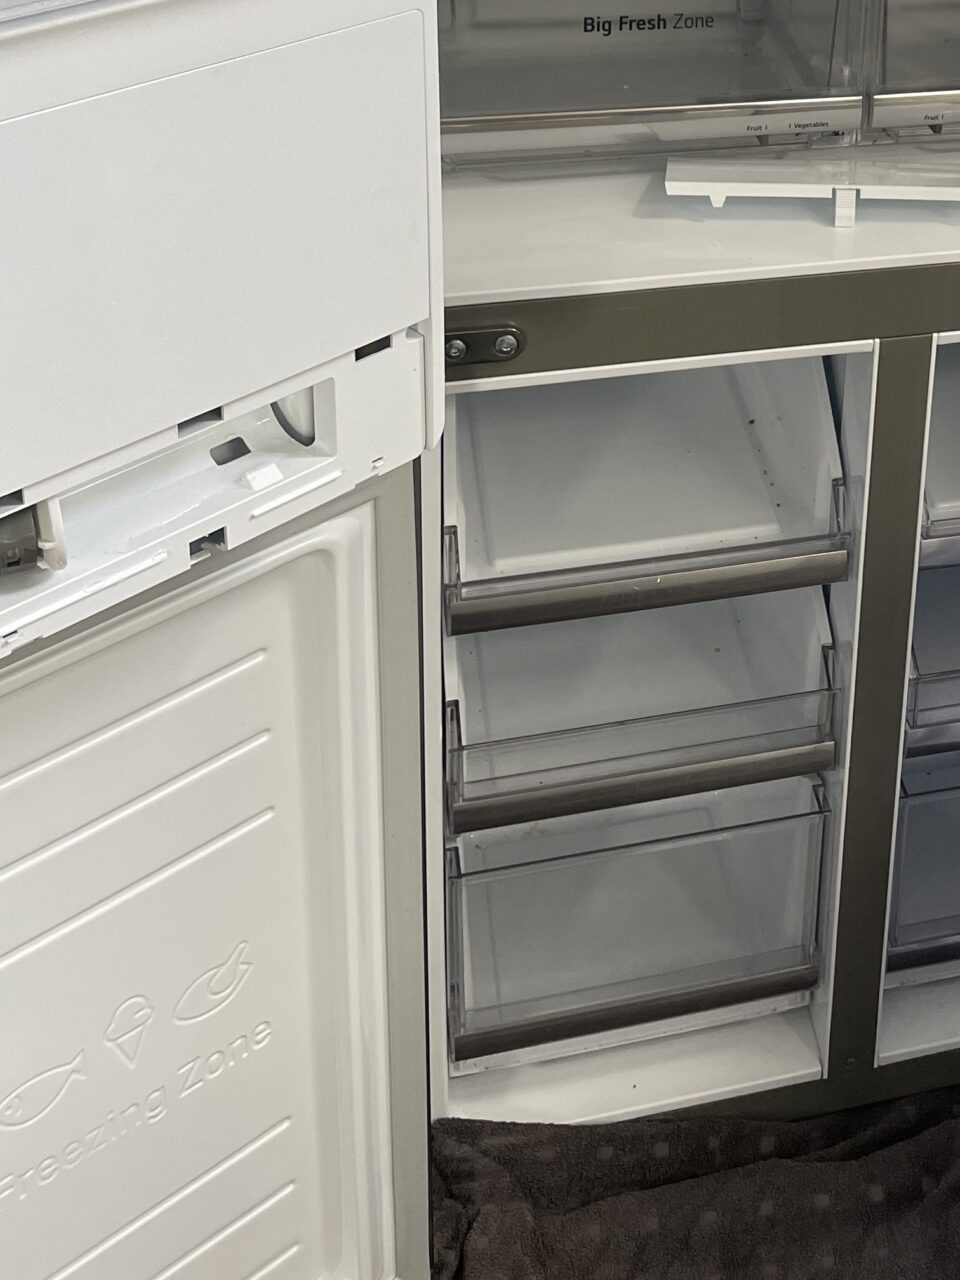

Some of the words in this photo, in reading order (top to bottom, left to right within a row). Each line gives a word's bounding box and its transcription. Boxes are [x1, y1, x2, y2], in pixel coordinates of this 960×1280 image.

[583, 16, 612, 36] Big
[618, 14, 667, 31] Fresh
[673, 13, 715, 29] Zone
[794, 121, 829, 129] Vegetables
